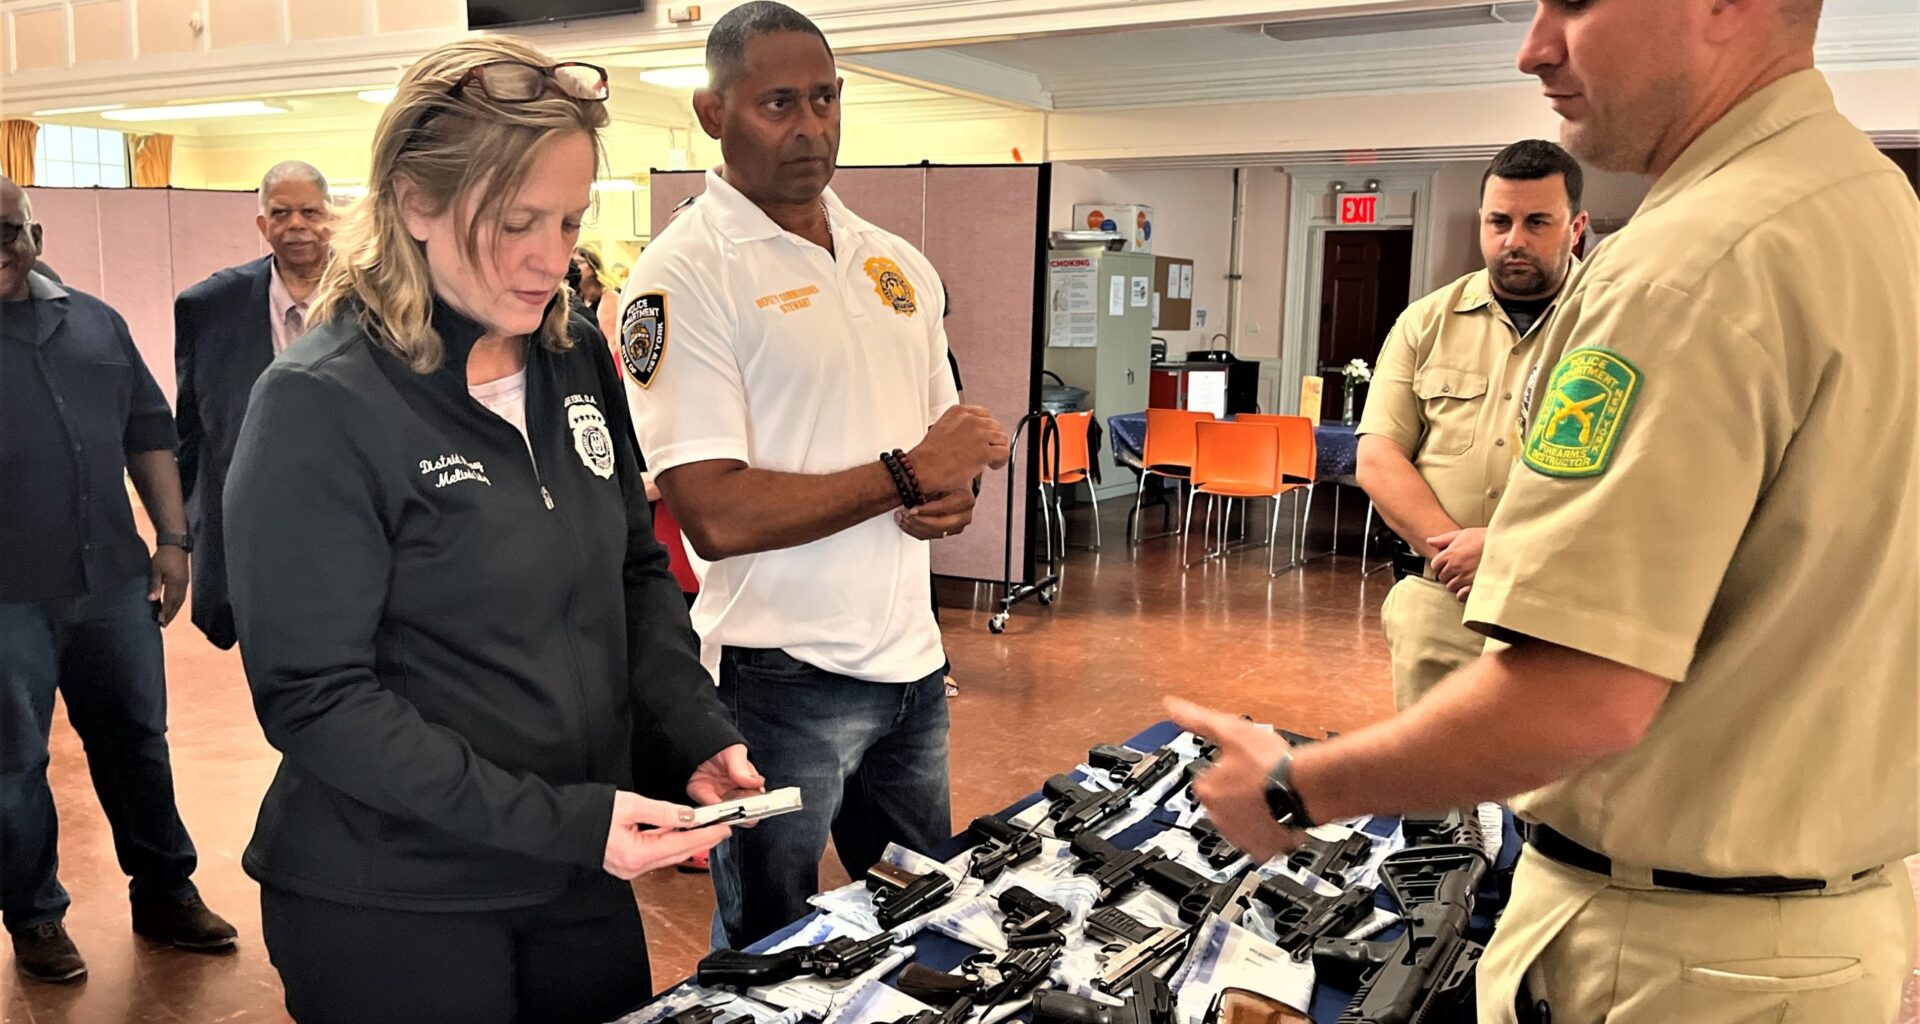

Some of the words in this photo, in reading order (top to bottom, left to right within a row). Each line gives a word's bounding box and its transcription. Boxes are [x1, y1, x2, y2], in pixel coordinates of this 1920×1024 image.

[1342, 196, 1377, 225] EXIT
[1050, 258, 1091, 268] CHOKING
[646, 352, 659, 374] NEW
[654, 321, 664, 351] YORK
[1570, 353, 1607, 370] POLICE
[1590, 420, 1612, 454] YORK
[1539, 443, 1588, 460] FIREARMS
